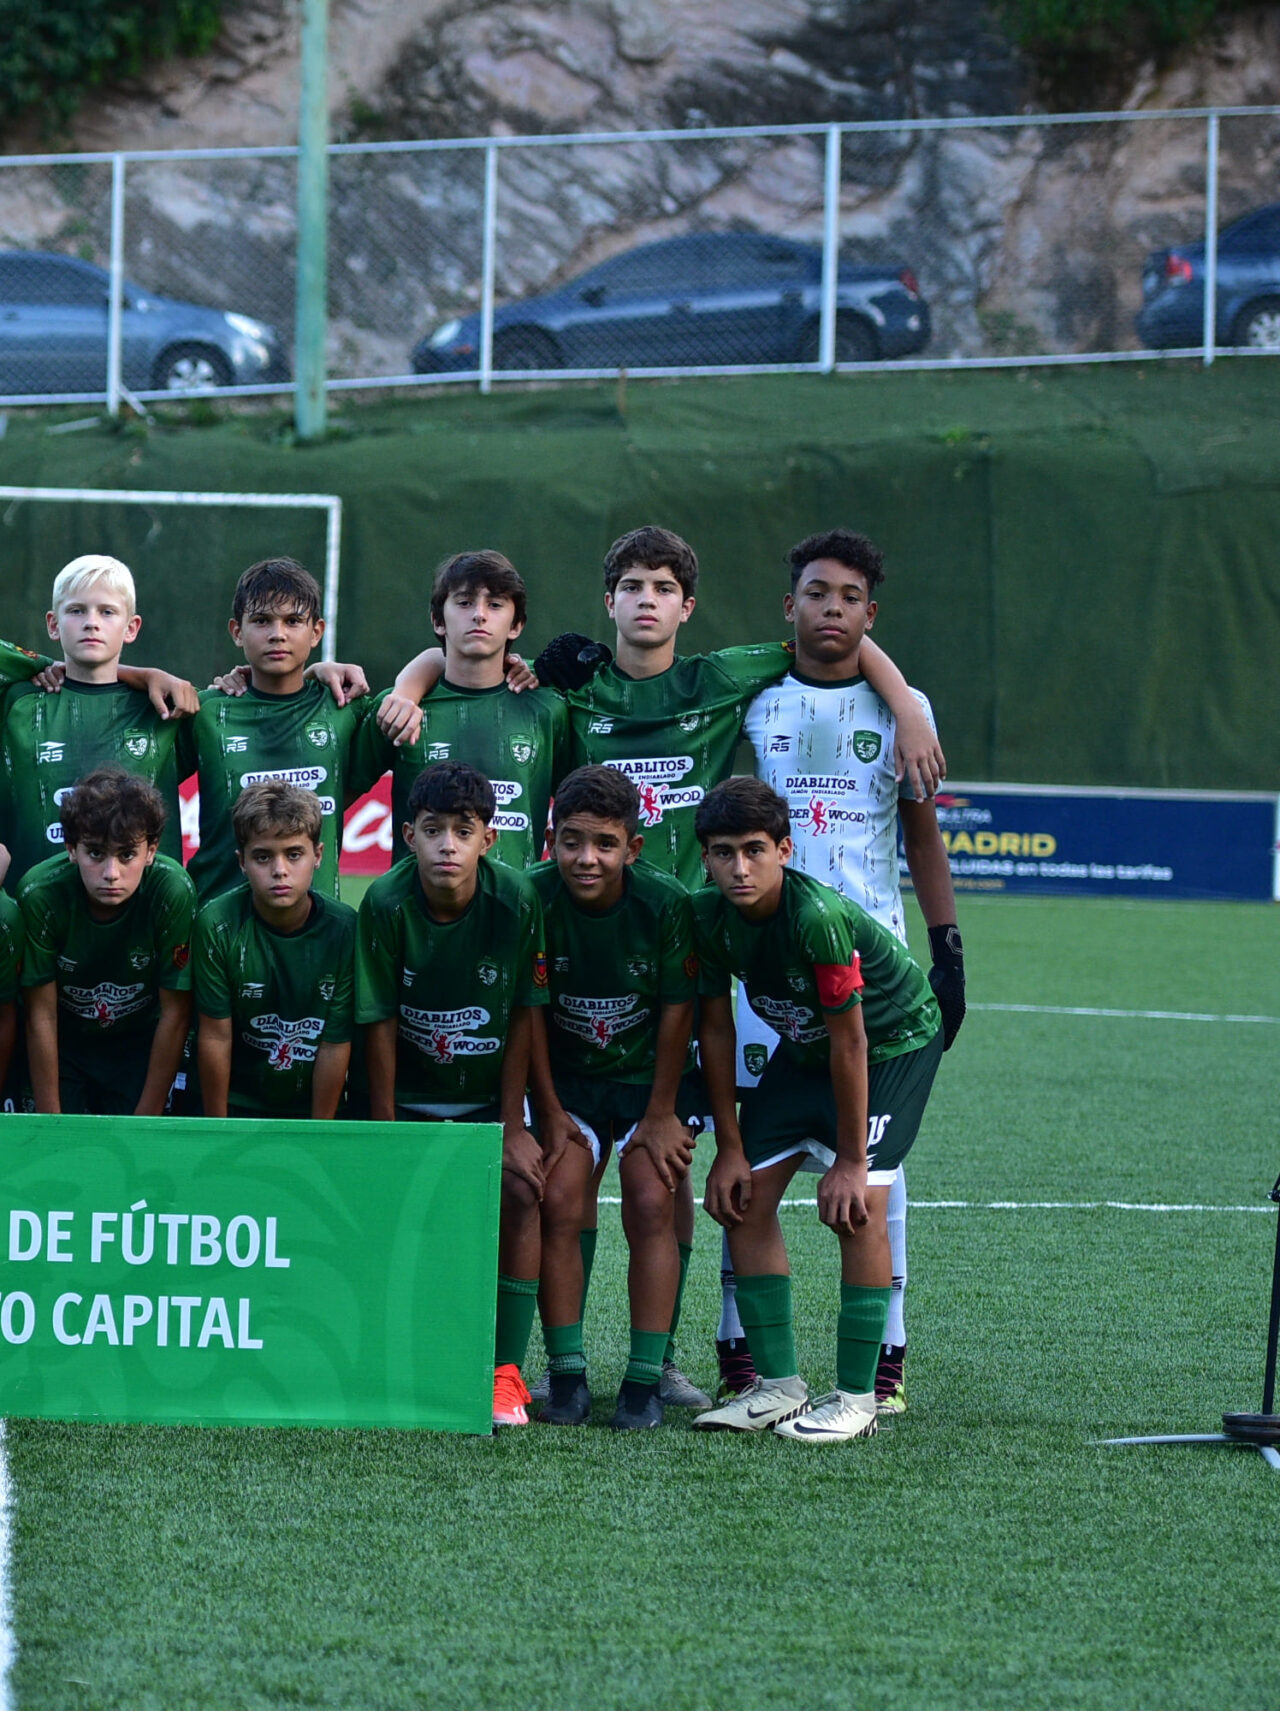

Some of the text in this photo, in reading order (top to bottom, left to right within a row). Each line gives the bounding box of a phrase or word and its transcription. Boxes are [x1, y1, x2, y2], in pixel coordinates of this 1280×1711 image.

[591, 723, 614, 734] RS
[226, 742, 247, 753] RS
[770, 742, 790, 752] RS
[39, 750, 63, 763] RS
[428, 749, 450, 760] RS
[786, 777, 857, 791] DIABLITOS
[660, 790, 701, 805] WOOD
[492, 815, 525, 827] WOOD
[789, 809, 866, 822] DER WOOD
[564, 995, 634, 1010] DIABLITOS
[404, 1008, 482, 1024] DIABLITOS
[292, 1046, 314, 1058] WO
[452, 1041, 496, 1052] WOOD
[8, 1210, 74, 1263] DE
[89, 1199, 291, 1268] FÚTBOL
[52, 1292, 264, 1350] CAPITAL
